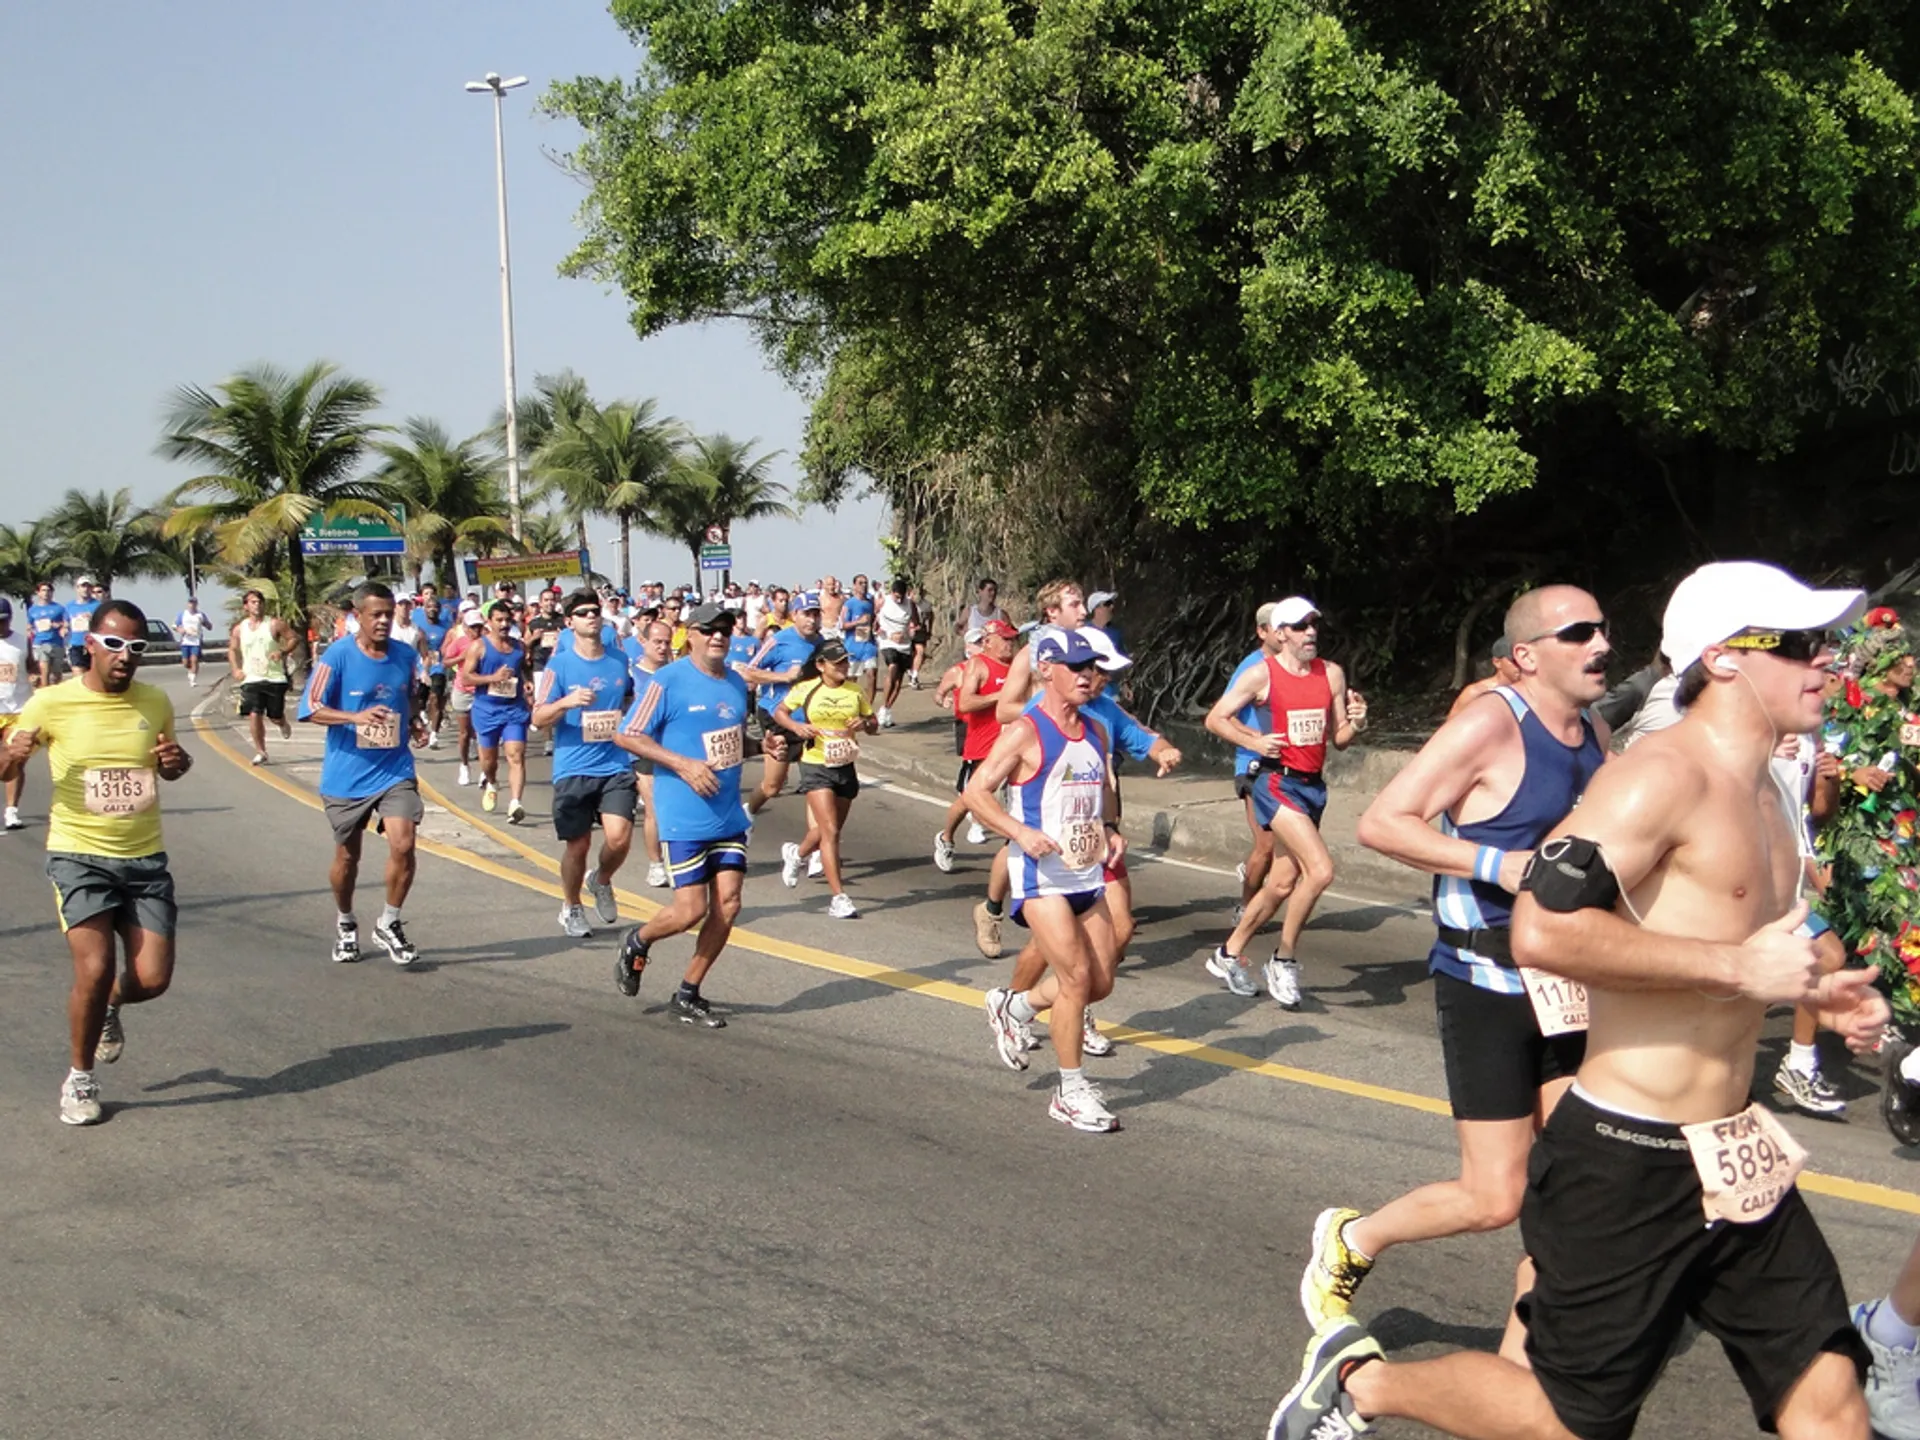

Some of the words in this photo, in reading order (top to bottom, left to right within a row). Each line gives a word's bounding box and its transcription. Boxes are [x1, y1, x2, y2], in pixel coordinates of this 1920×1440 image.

[319, 529, 359, 537] Retorno
[320, 542, 359, 551] Mirante
[363, 724, 395, 738] 4737
[100, 769, 131, 781] FISK
[90, 781, 143, 798] 13163
[103, 803, 135, 813] CAIXA
